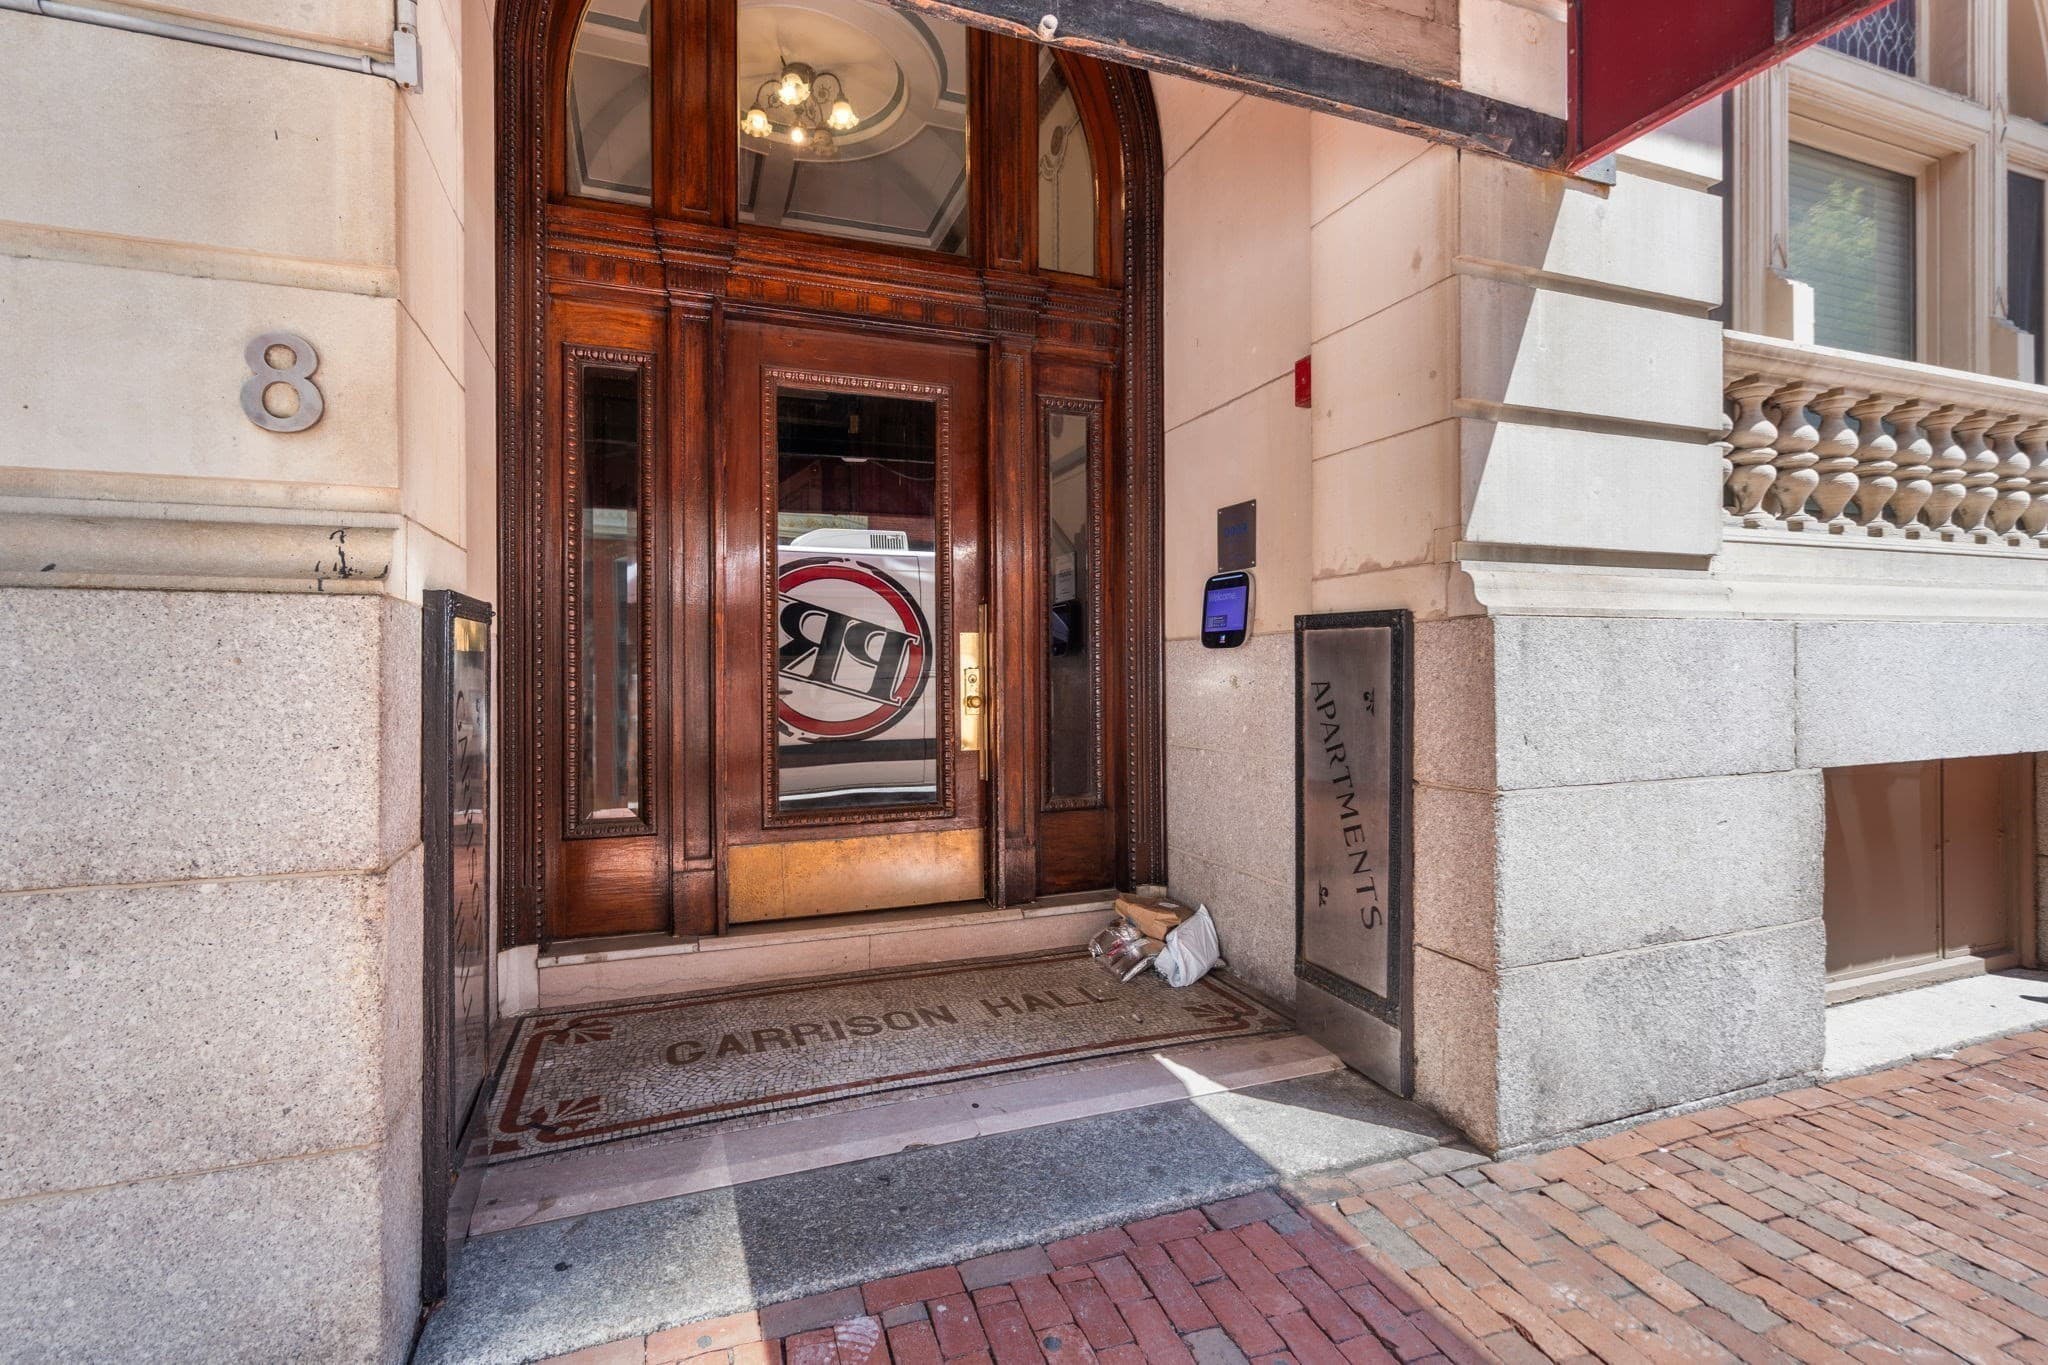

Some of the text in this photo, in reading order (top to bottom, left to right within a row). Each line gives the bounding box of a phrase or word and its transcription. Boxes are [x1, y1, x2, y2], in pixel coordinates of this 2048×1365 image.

[240, 332, 324, 433] 8
[1311, 681, 1383, 930] APARTMENTS
[665, 984, 1121, 1067] GARRISON HALL
